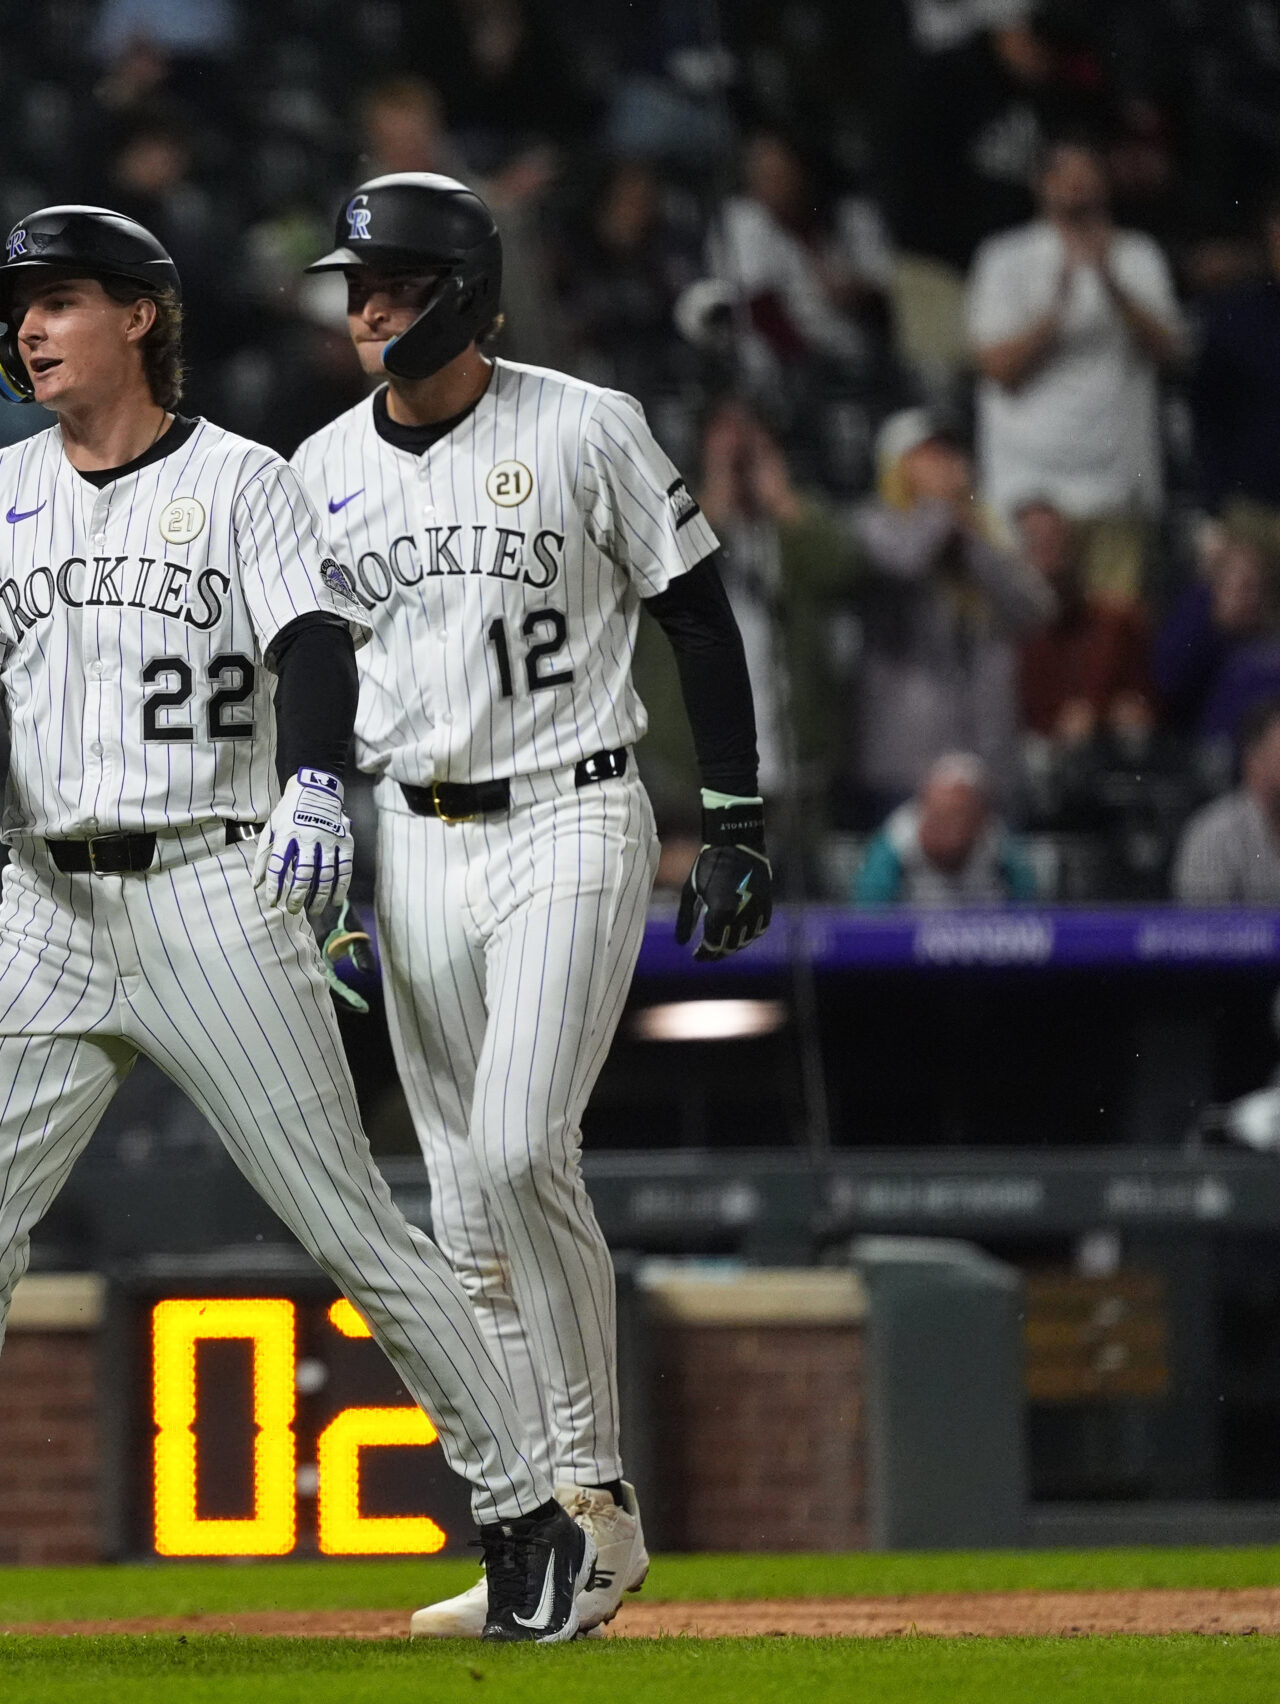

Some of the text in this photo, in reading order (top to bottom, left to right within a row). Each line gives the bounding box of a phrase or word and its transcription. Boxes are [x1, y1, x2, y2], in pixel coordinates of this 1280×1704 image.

[495, 470, 522, 496] 21
[167, 507, 196, 532] 21
[487, 607, 575, 699] 12
[139, 652, 257, 744] 22
